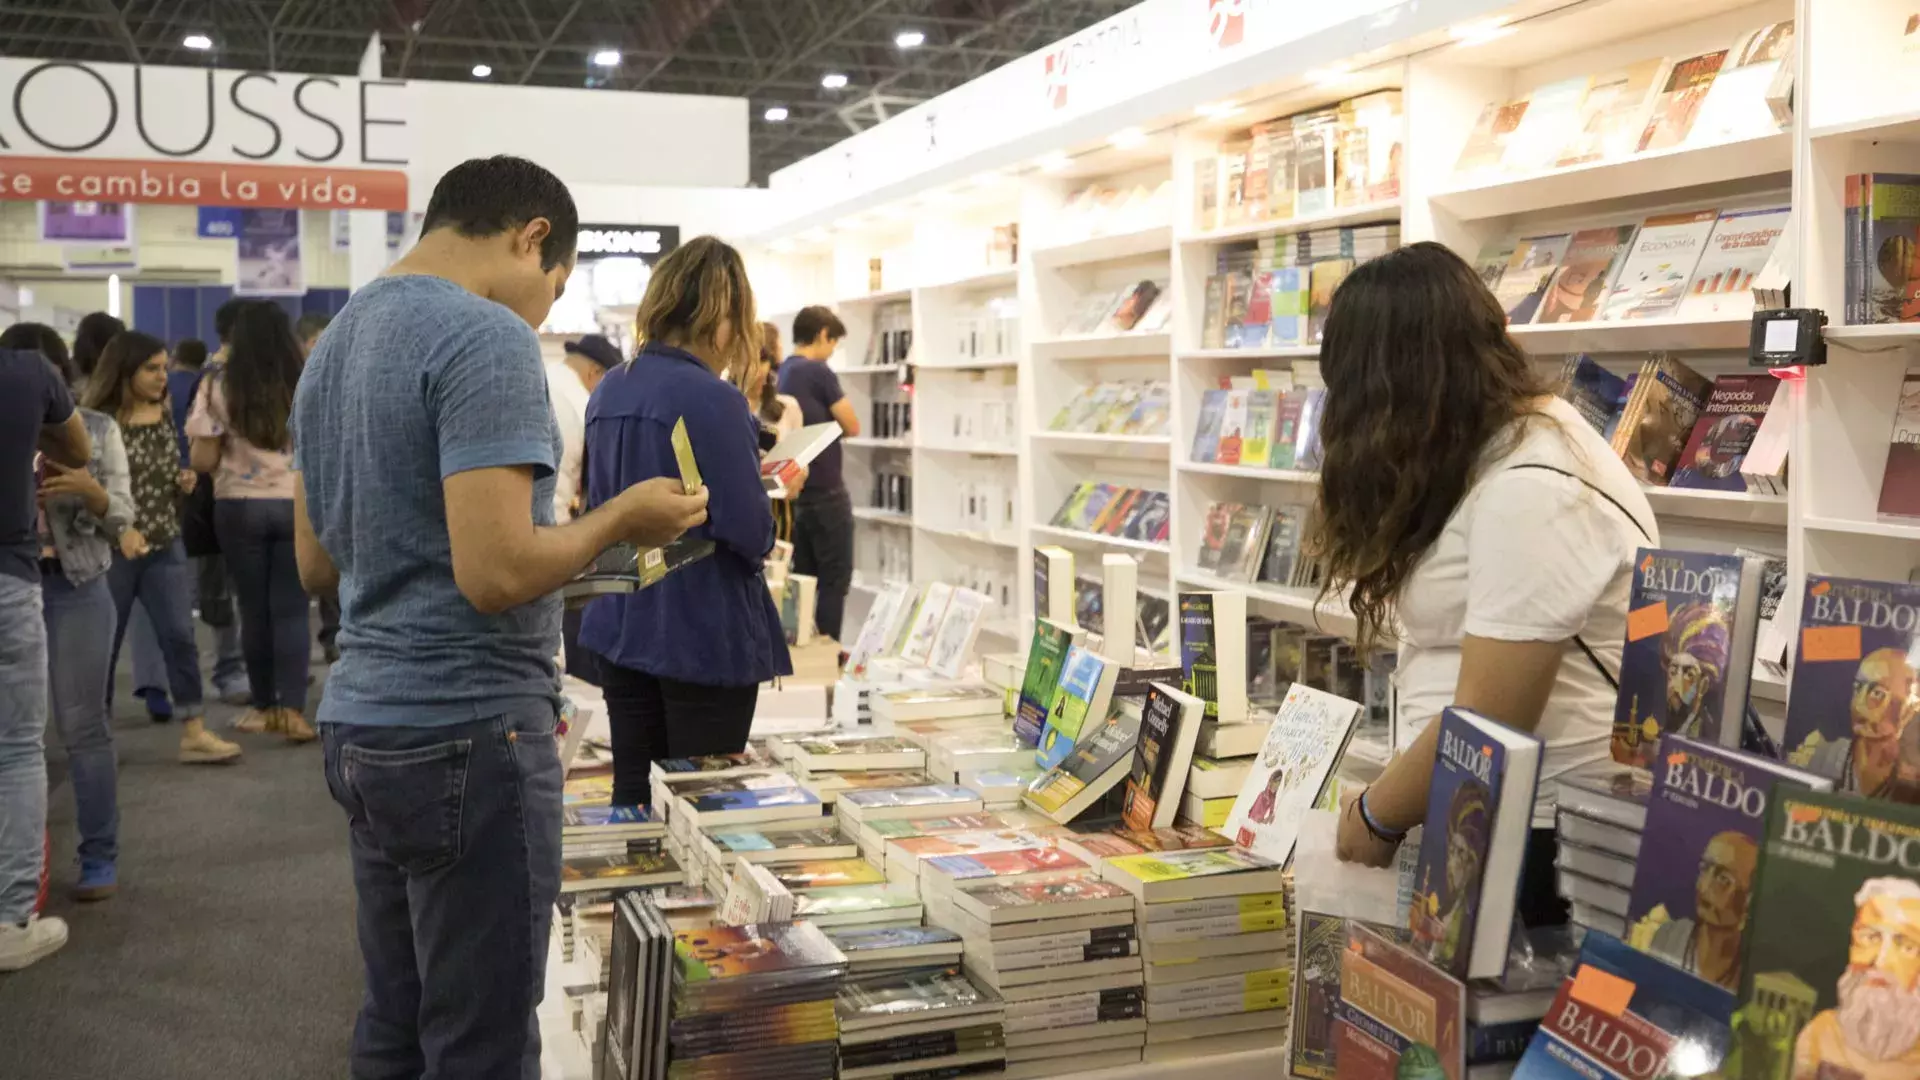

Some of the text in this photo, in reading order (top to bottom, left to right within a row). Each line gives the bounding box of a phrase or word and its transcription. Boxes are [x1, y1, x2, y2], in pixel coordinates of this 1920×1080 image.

[0, 60, 409, 166] OUSSE
[56, 169, 200, 197] cambia
[220, 171, 259, 200] la
[279, 173, 368, 205] vida.
[1711, 390, 1755, 405] Negocios
[1442, 729, 1492, 786] BALDOR
[1349, 972, 1430, 1042] BALDOR
